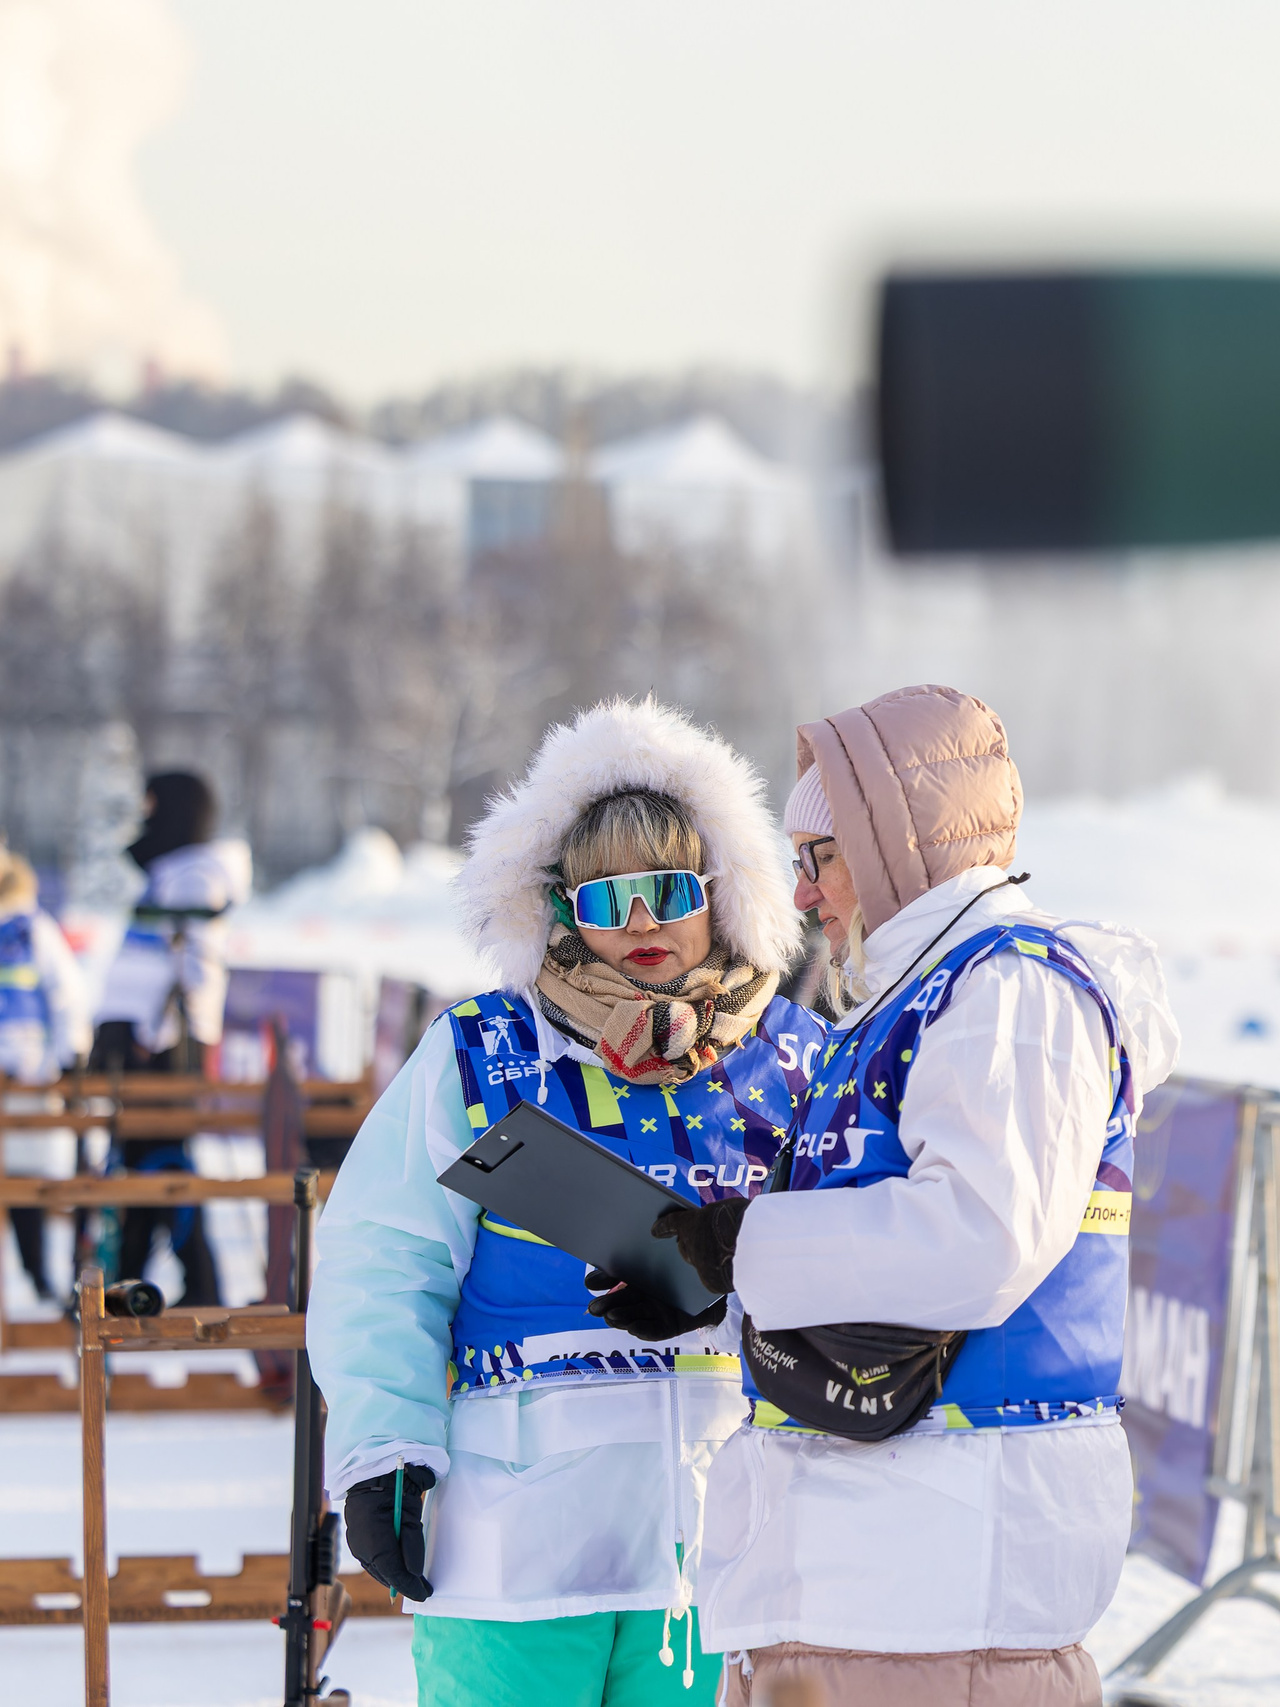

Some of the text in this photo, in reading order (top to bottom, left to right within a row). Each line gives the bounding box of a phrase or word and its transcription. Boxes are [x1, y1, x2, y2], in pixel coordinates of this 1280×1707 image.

[688, 1164, 768, 1187] CUP
[1120, 1287, 1210, 1428] МАН
[825, 1379, 895, 1416] VLNT
